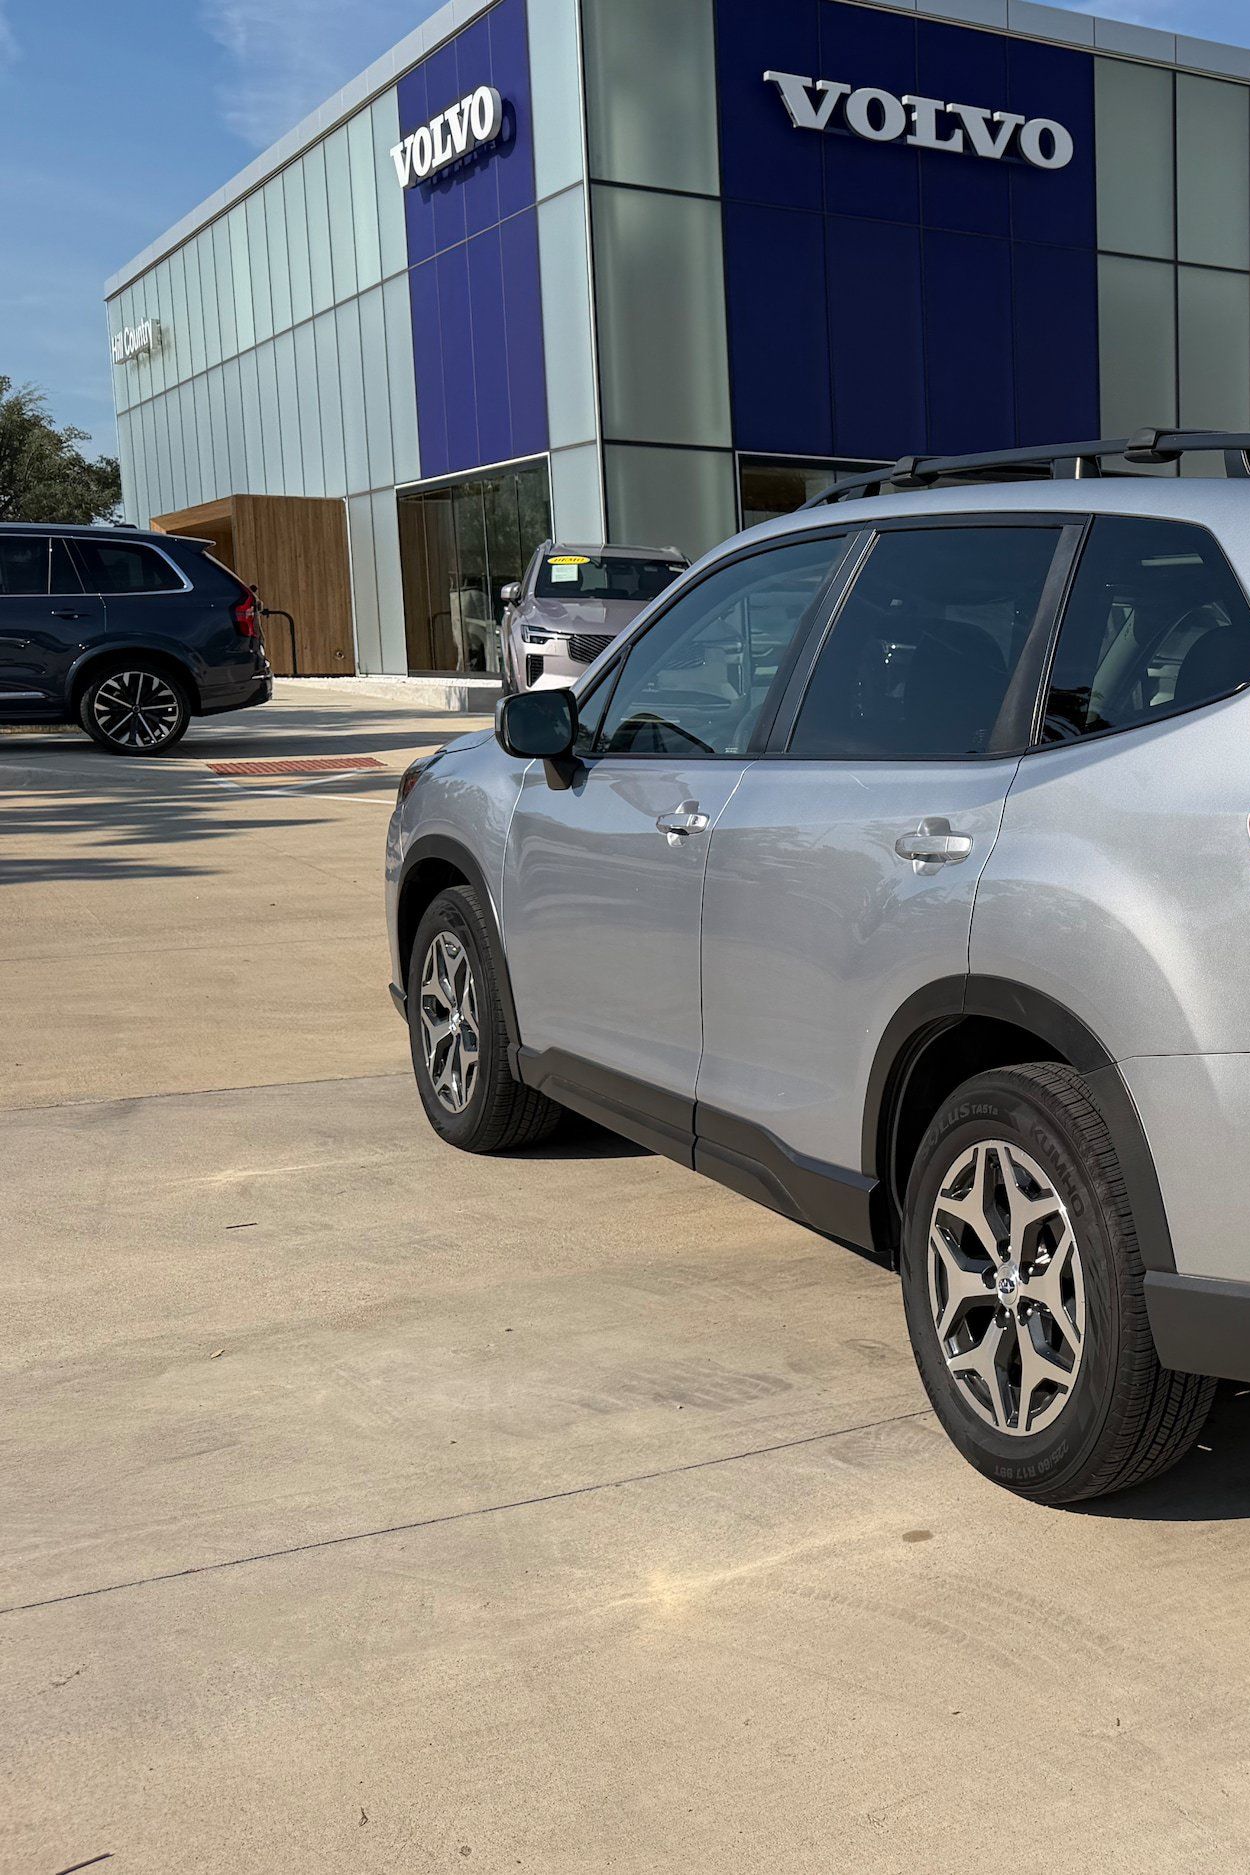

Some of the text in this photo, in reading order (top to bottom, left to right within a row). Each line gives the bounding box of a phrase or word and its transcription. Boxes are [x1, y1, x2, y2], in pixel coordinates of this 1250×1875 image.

[389, 85, 502, 189] VOLVO
[763, 70, 1074, 169] VOLVO
[111, 317, 153, 364] Hill Country
